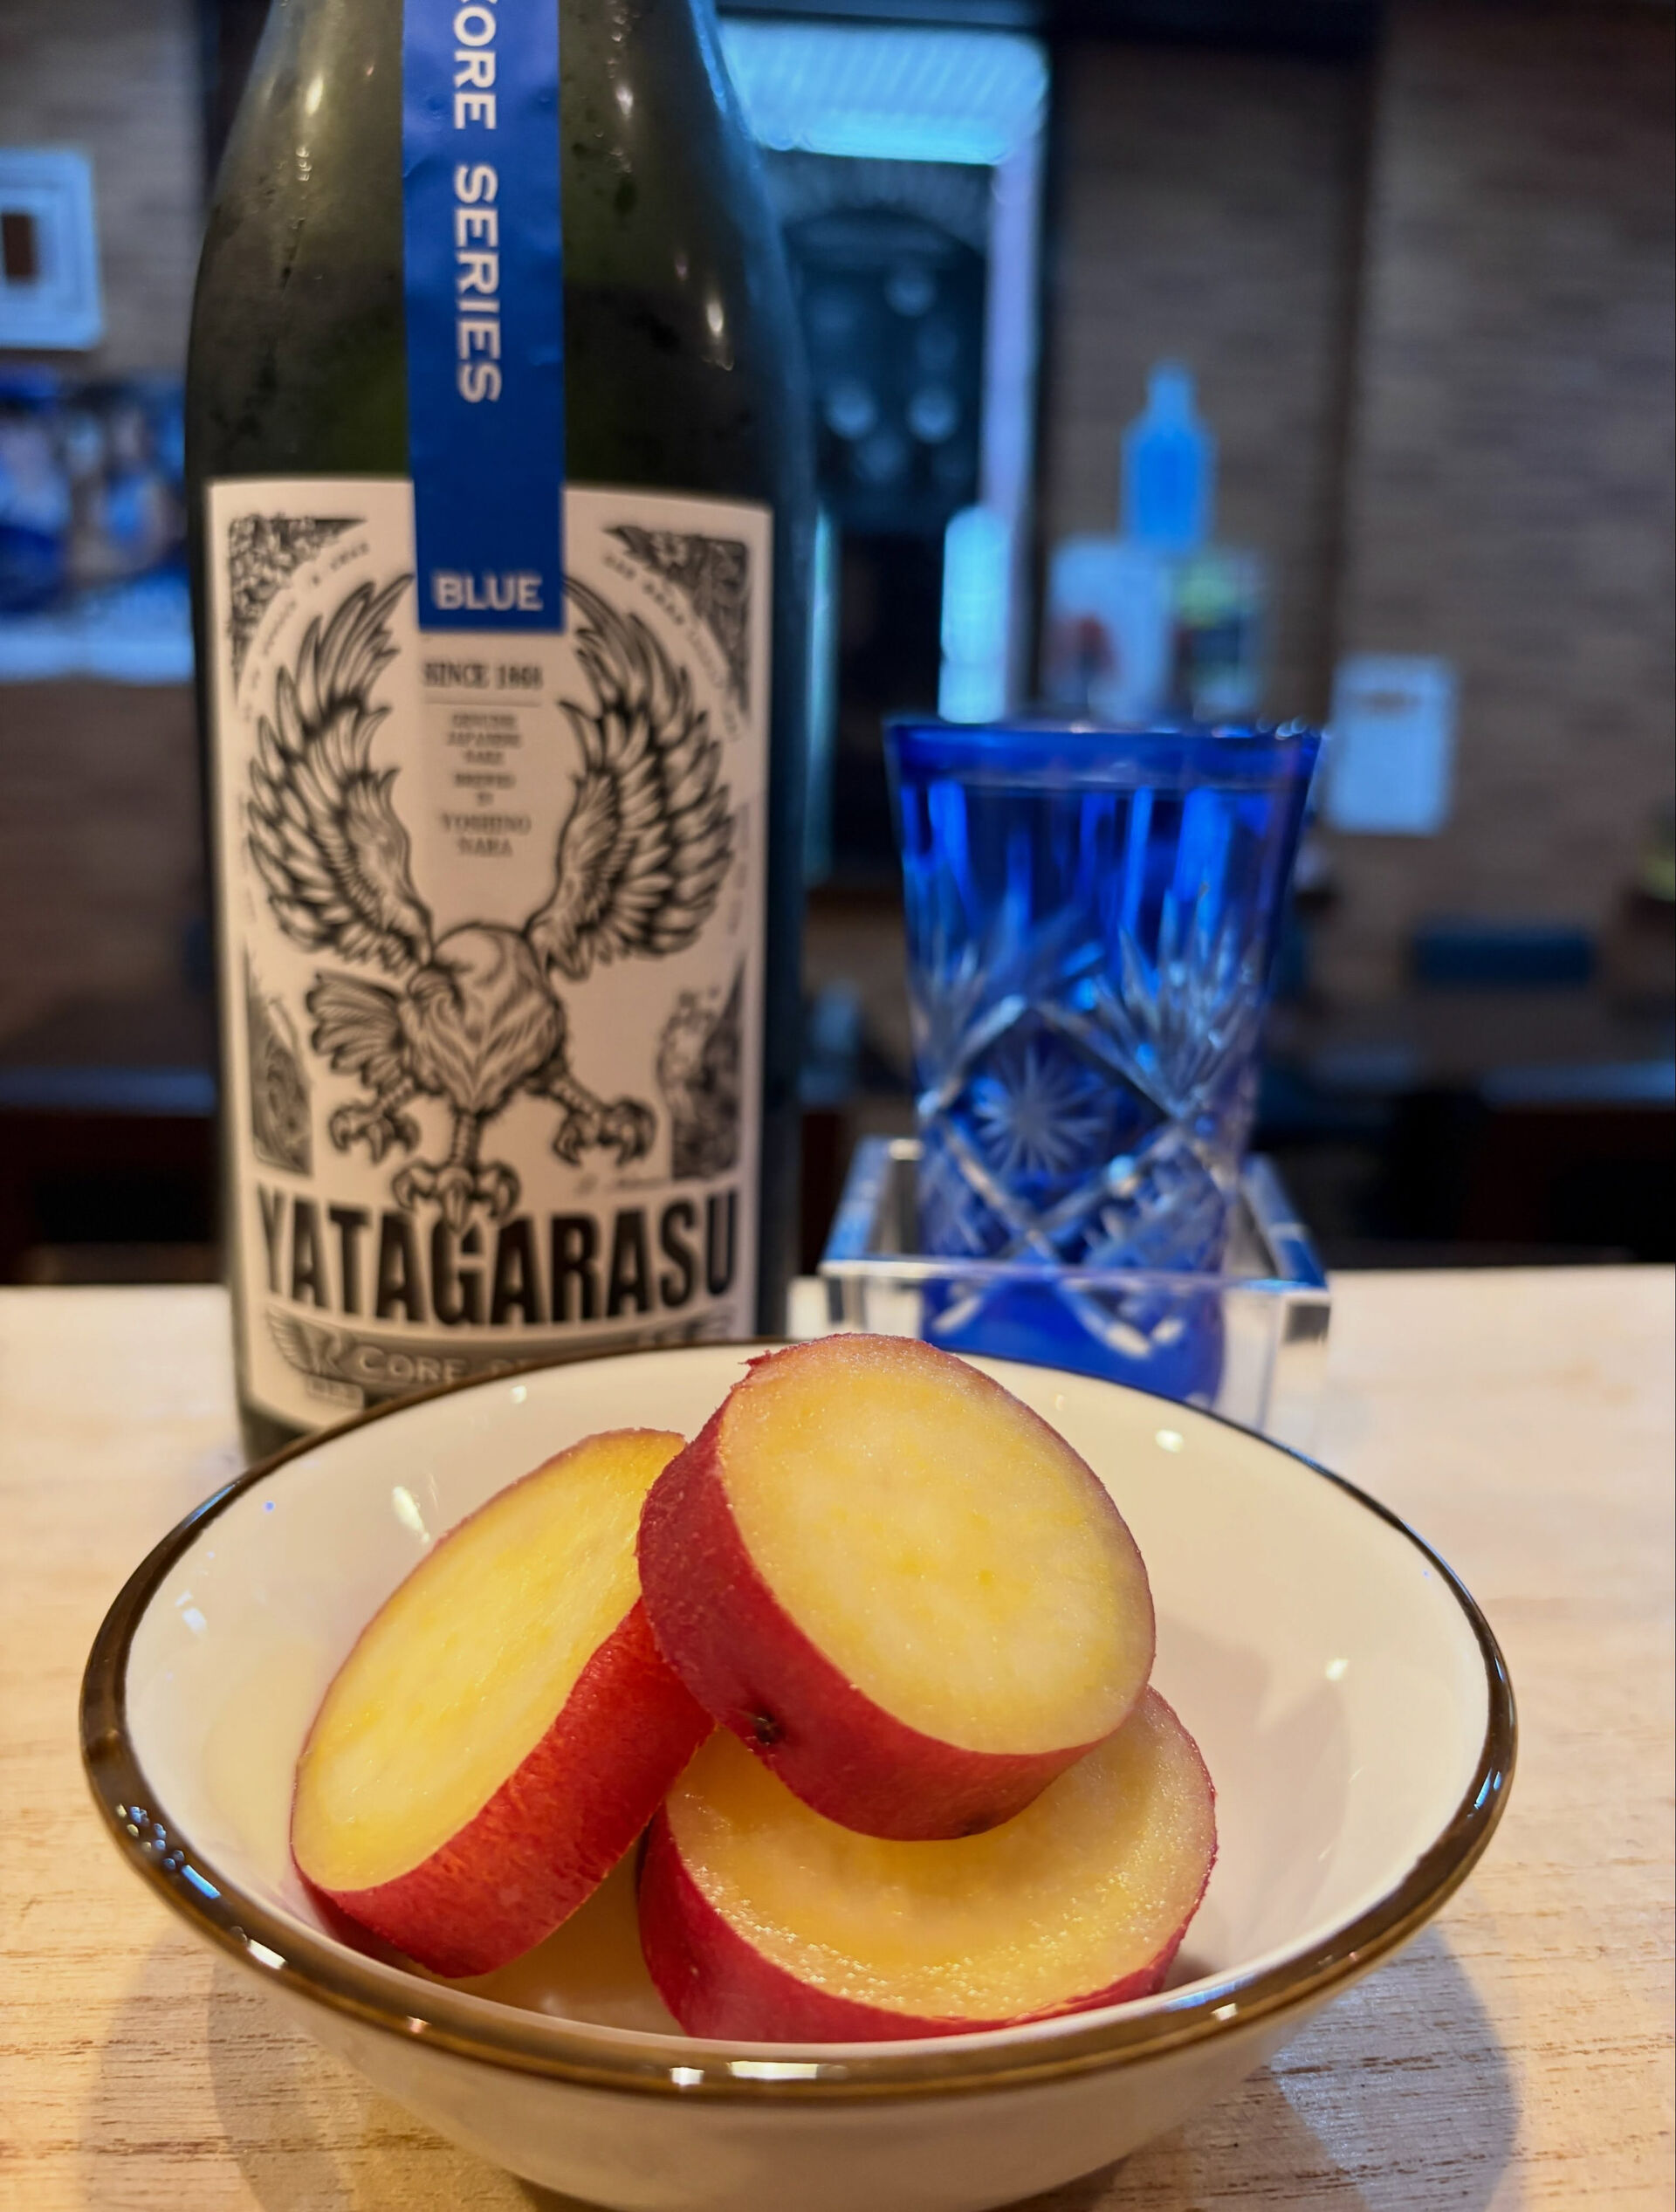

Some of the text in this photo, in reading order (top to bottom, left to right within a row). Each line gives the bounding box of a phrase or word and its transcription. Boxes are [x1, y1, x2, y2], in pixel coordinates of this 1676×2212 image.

[454, 0, 501, 403] ORE SERIES
[434, 574, 542, 610] BLUE
[423, 662, 489, 688] SINCE
[259, 1184, 738, 1328] YATAGARASU
[350, 1344, 468, 1384] CORE
